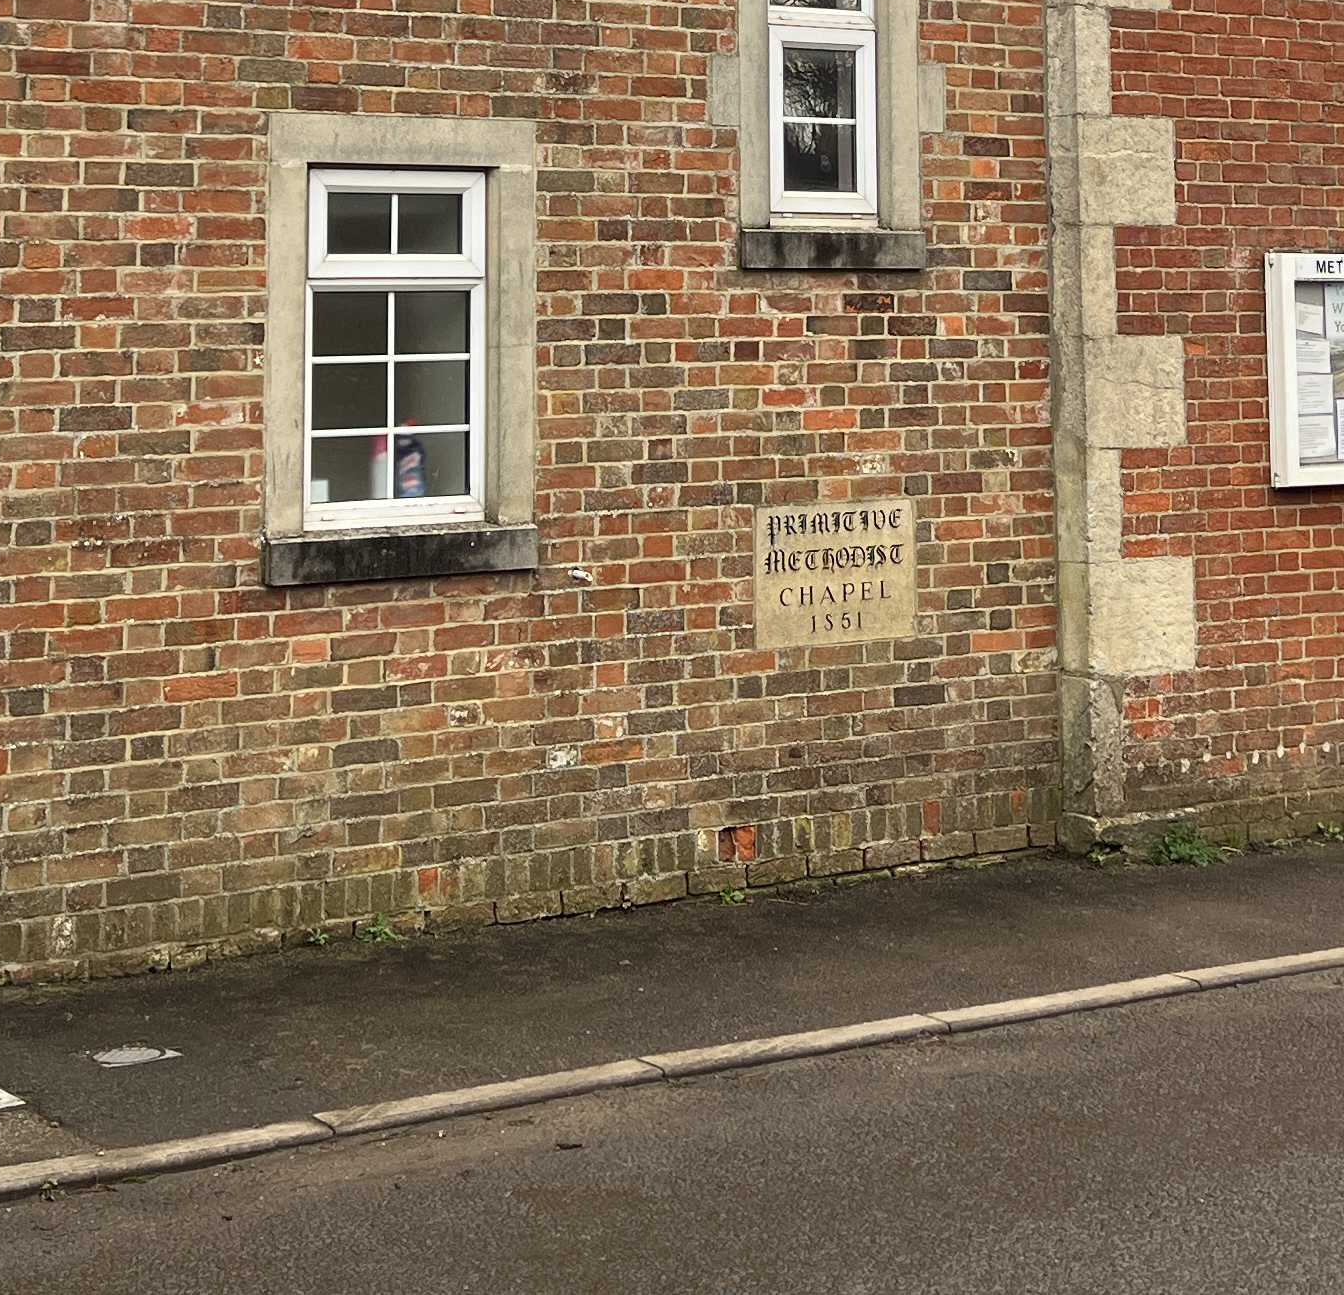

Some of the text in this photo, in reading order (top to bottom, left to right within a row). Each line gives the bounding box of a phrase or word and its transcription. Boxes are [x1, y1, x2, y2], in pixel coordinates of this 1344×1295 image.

[767, 509, 903, 545] PRIMITIVE
[764, 543, 905, 575] METHODIST
[779, 580, 892, 607] CHAPEL
